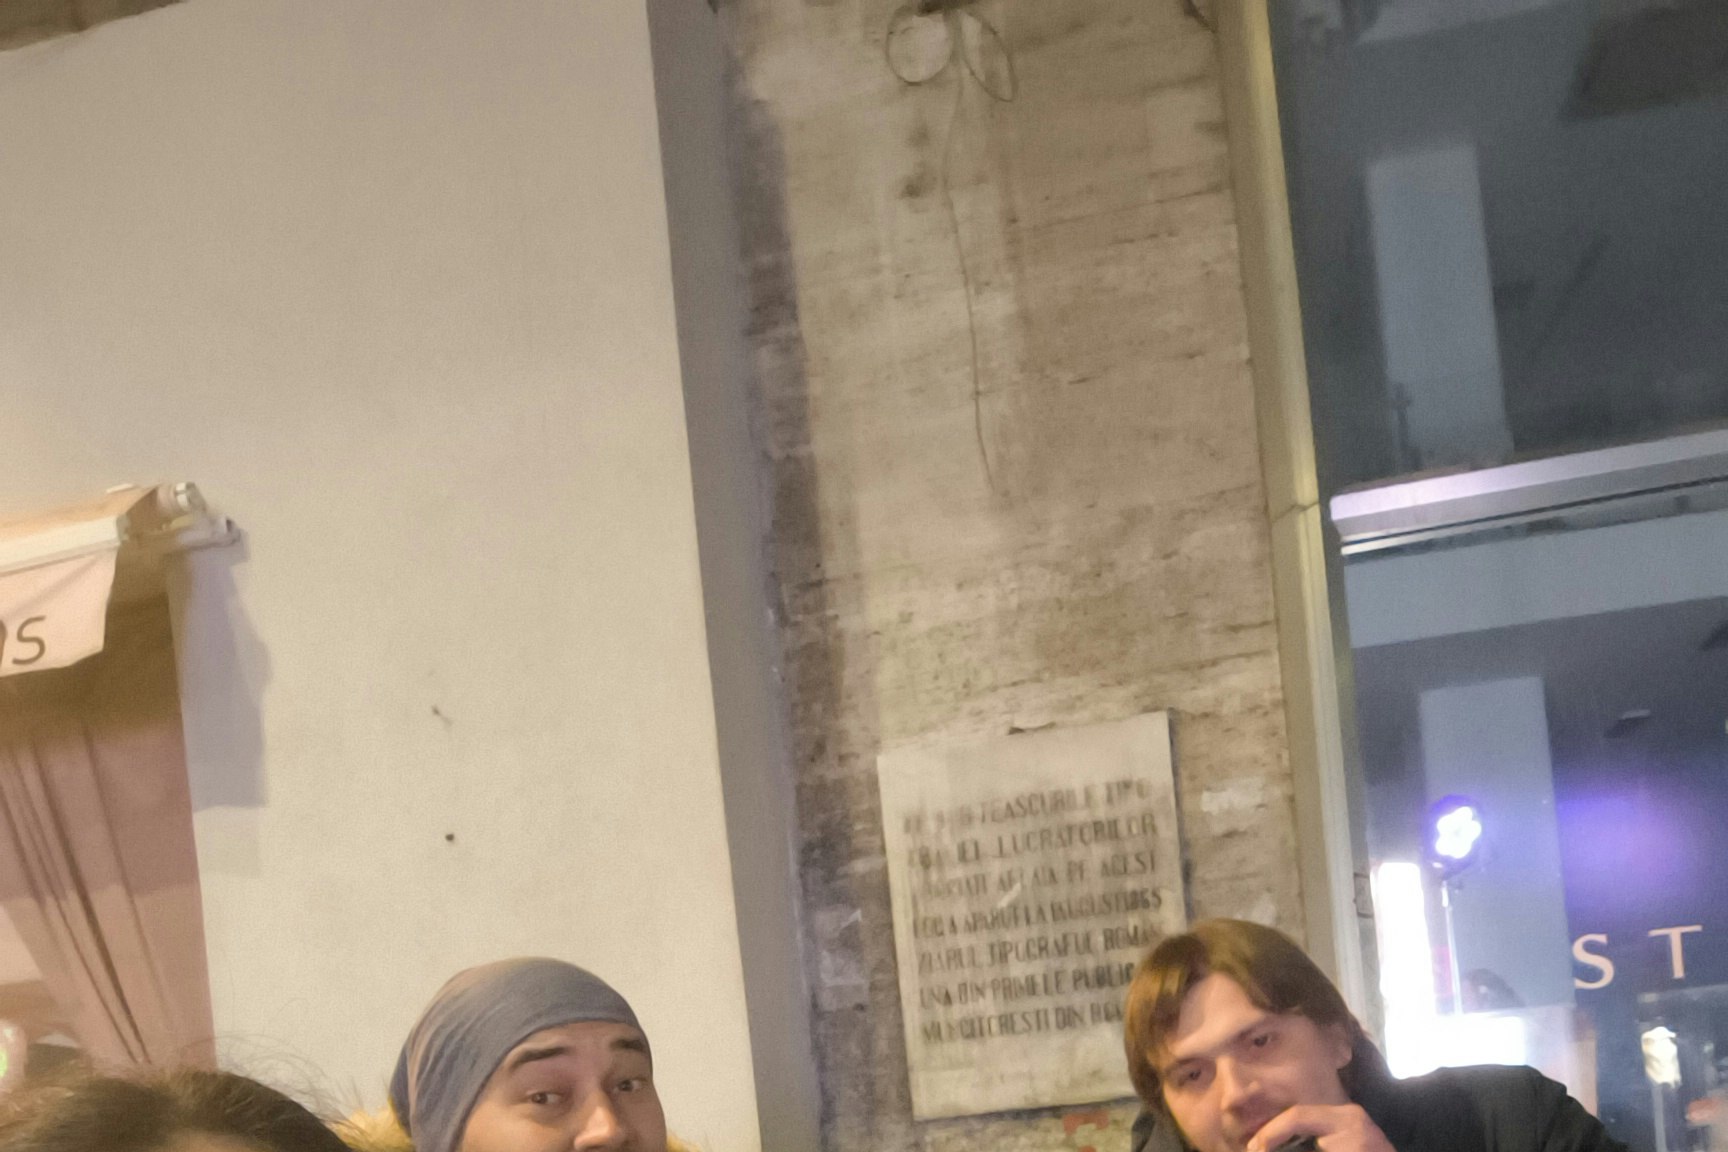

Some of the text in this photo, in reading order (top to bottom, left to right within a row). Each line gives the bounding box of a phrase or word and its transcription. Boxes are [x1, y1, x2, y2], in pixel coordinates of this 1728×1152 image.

[1100, 851, 1157, 879] ACEST
[957, 981, 986, 1005] DIN
[1054, 1004, 1085, 1030] DIN
